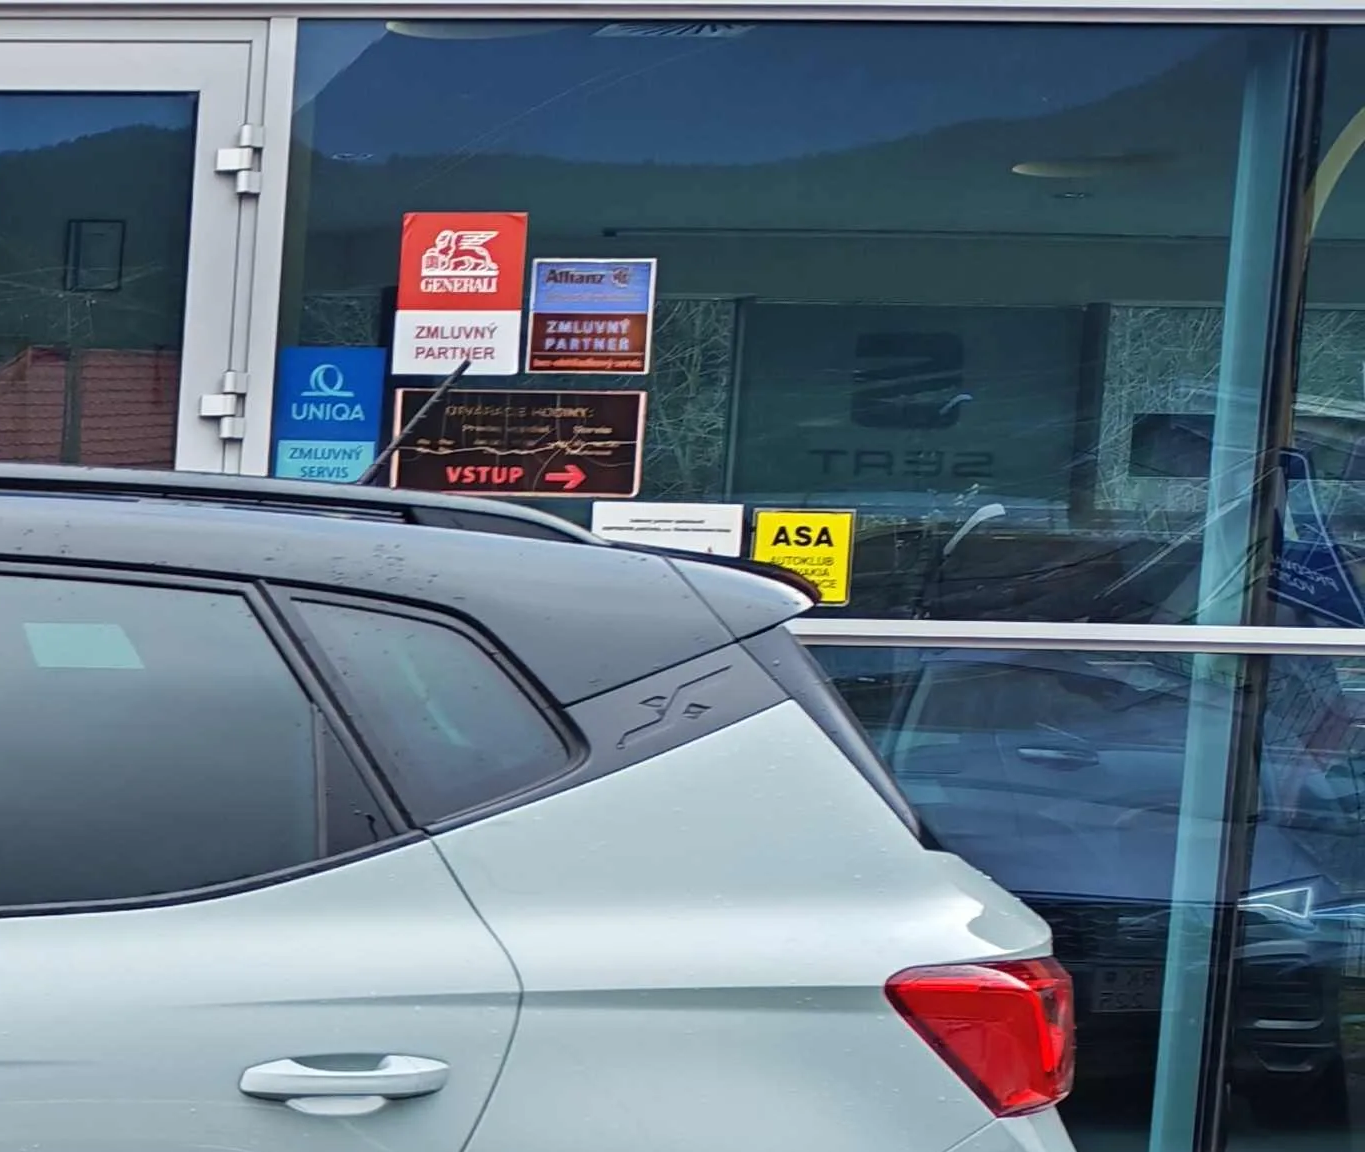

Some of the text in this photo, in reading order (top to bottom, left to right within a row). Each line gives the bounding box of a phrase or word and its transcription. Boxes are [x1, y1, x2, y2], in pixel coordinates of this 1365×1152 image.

[420, 277, 498, 293] GENERALI
[546, 269, 605, 285] Allianz
[414, 322, 498, 340] ZMLUVNÝ
[546, 318, 630, 334] ZMLUVNÝ
[544, 337, 629, 351] PARTNER
[414, 346, 496, 361] PARTNER
[291, 402, 366, 421] UNIQA
[287, 444, 364, 461] ZMLUVNÝ
[300, 466, 350, 479] SERVIS
[446, 466, 524, 484] VSTUP
[771, 525, 835, 548] ASA
[771, 555, 834, 567] AUTOKLUB
